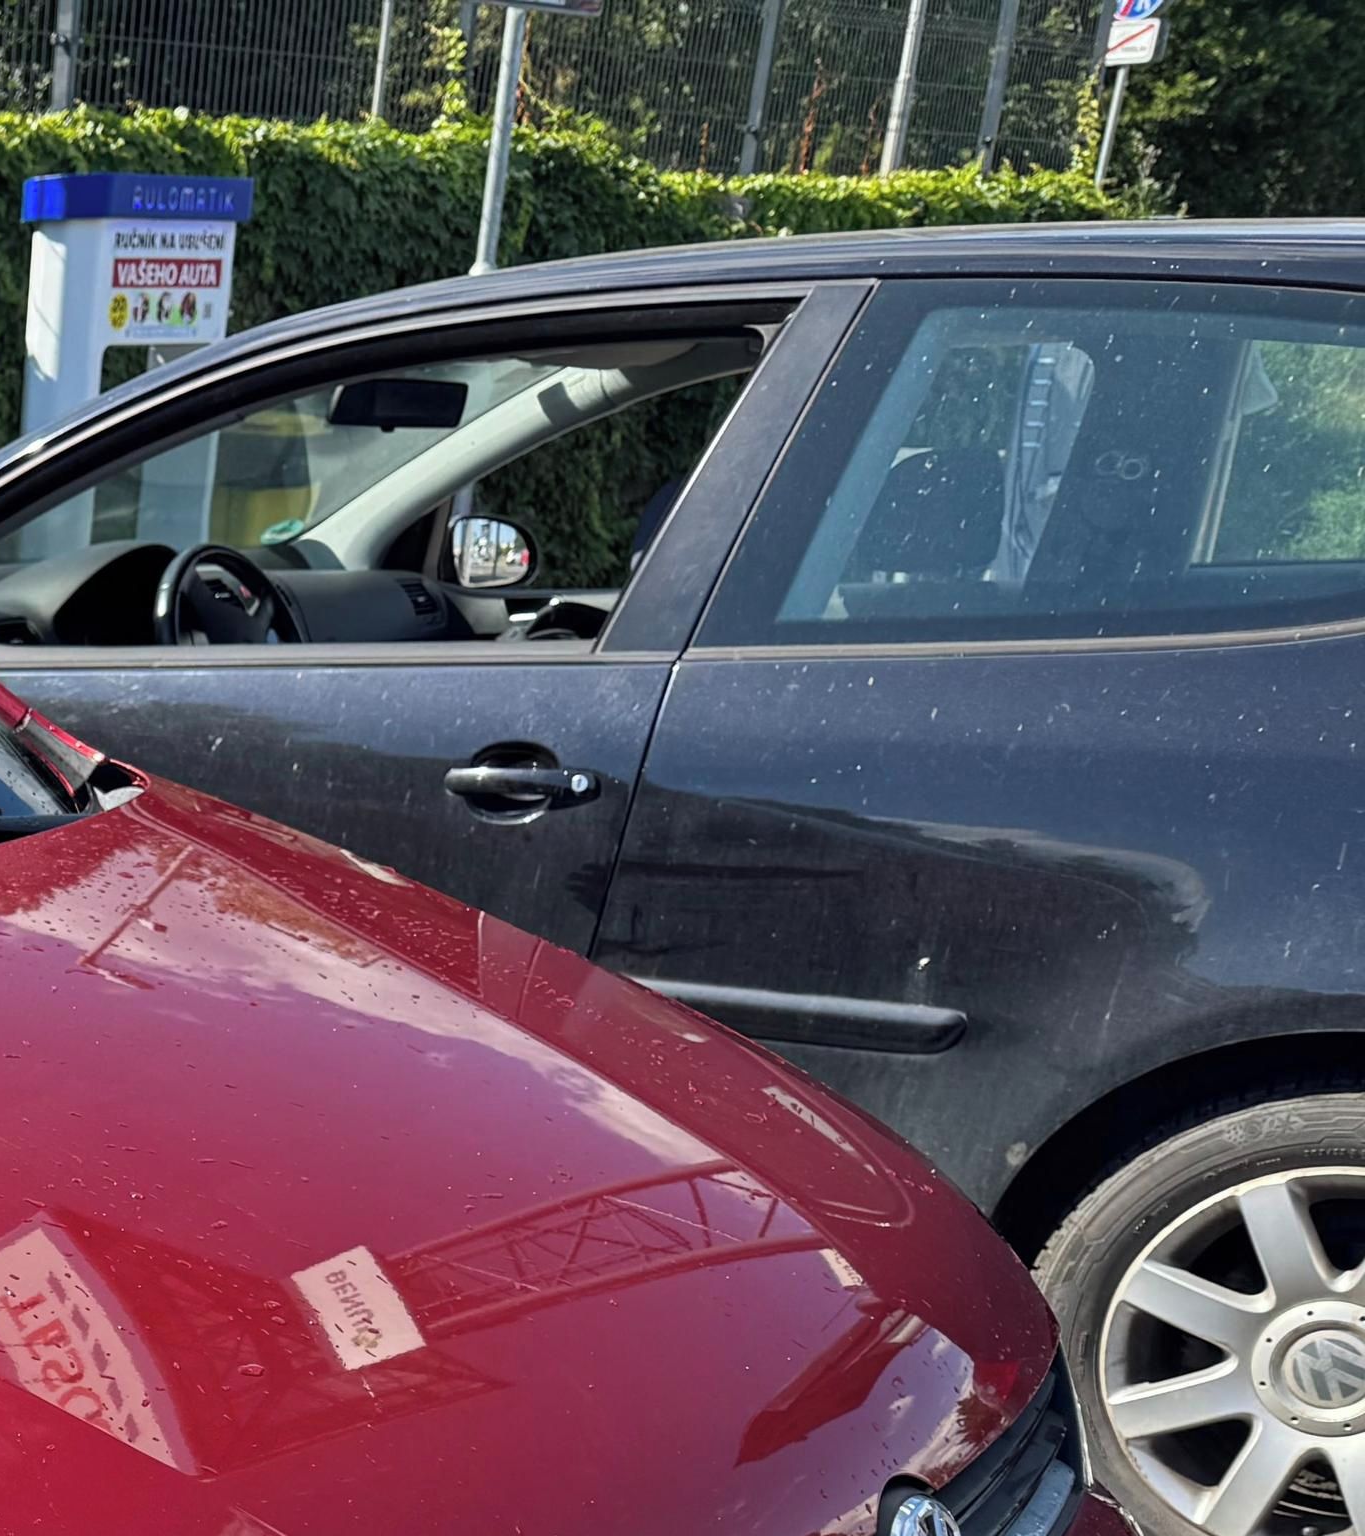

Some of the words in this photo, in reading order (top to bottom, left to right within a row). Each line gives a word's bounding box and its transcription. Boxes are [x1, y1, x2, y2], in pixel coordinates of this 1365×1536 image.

[114, 228, 157, 249] RUČNÍK
[117, 259, 178, 287] VAŠEHO
[178, 262, 218, 287] AUTA
